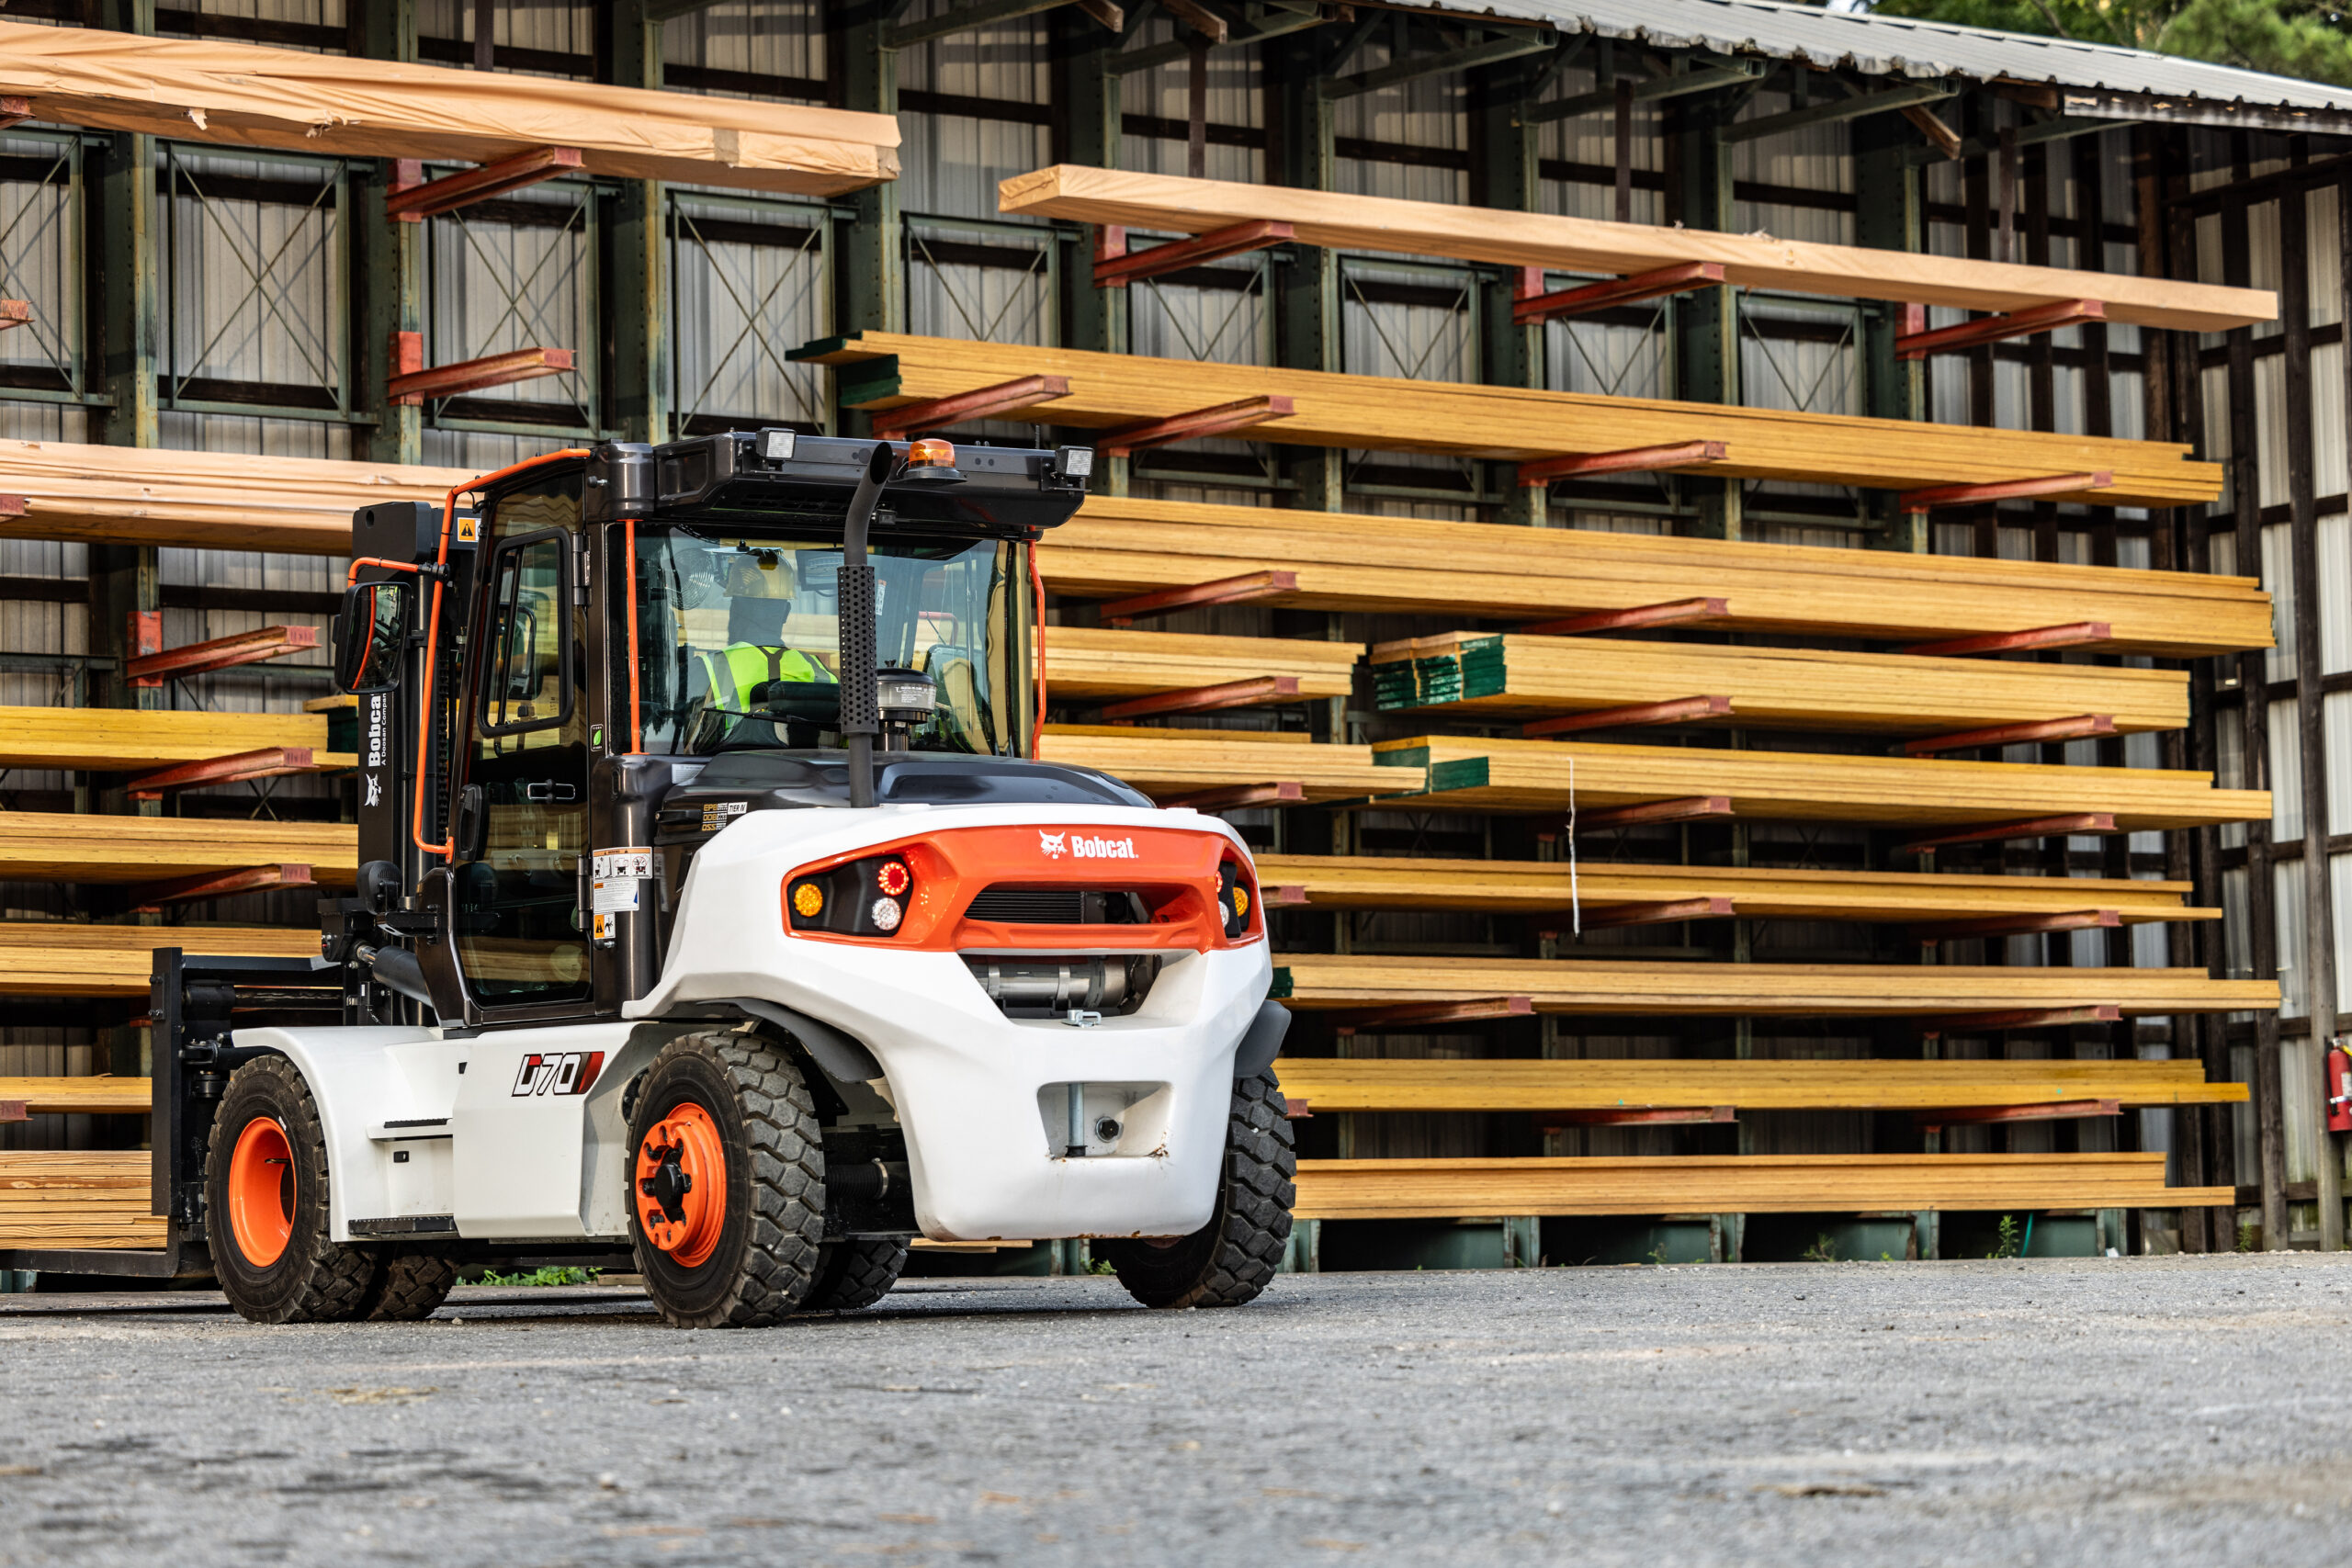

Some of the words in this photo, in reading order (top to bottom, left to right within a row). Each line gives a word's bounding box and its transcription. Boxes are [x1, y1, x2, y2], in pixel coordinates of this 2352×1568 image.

[368, 693, 381, 767] Bobca
[1071, 836, 1136, 859] Bobcat
[512, 1052, 582, 1097] D70
